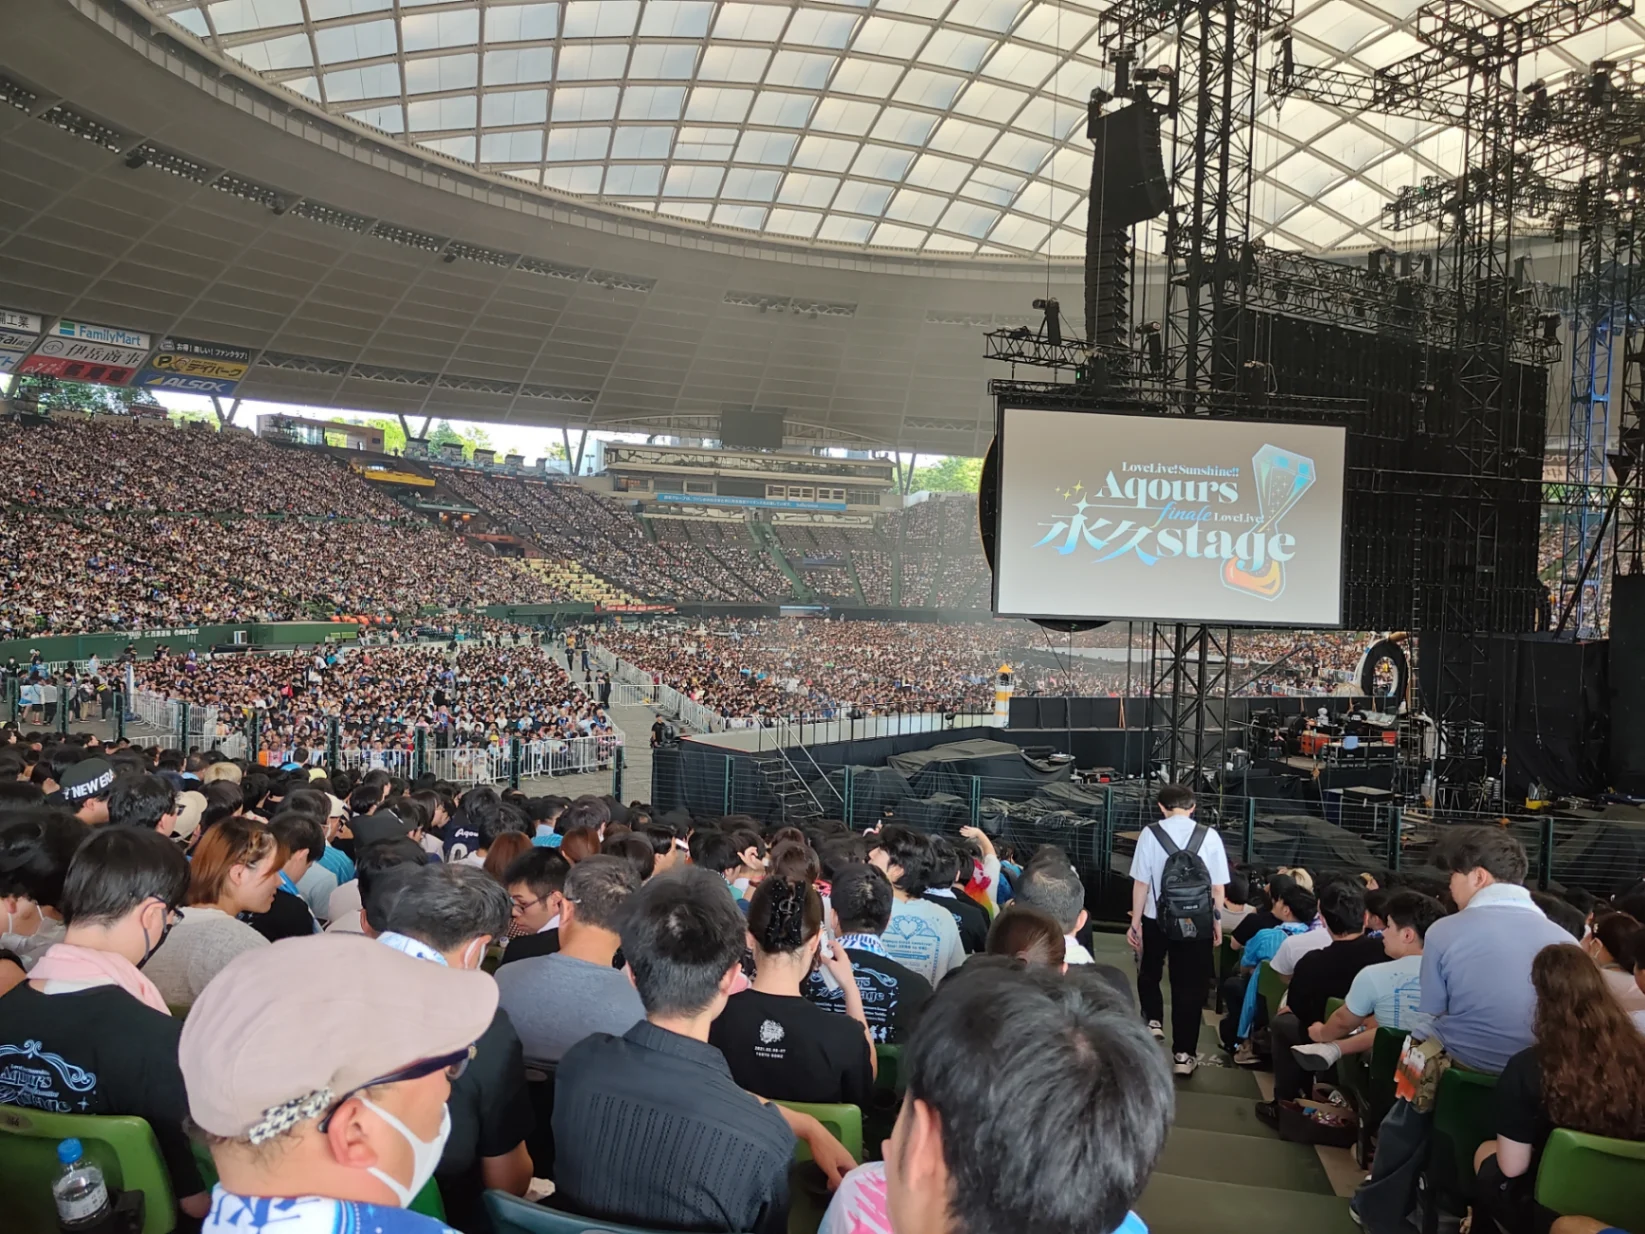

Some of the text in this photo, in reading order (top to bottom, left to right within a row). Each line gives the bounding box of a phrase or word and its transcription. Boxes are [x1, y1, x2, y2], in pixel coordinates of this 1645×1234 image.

[79, 325, 141, 346] FamilyMart
[161, 377, 227, 392] ALSOK
[1094, 470, 1239, 508] Aqours
[1152, 501, 1266, 525] finale LoveLive!
[71, 778, 99, 799] NEW
[454, 827, 479, 839] Aqou
